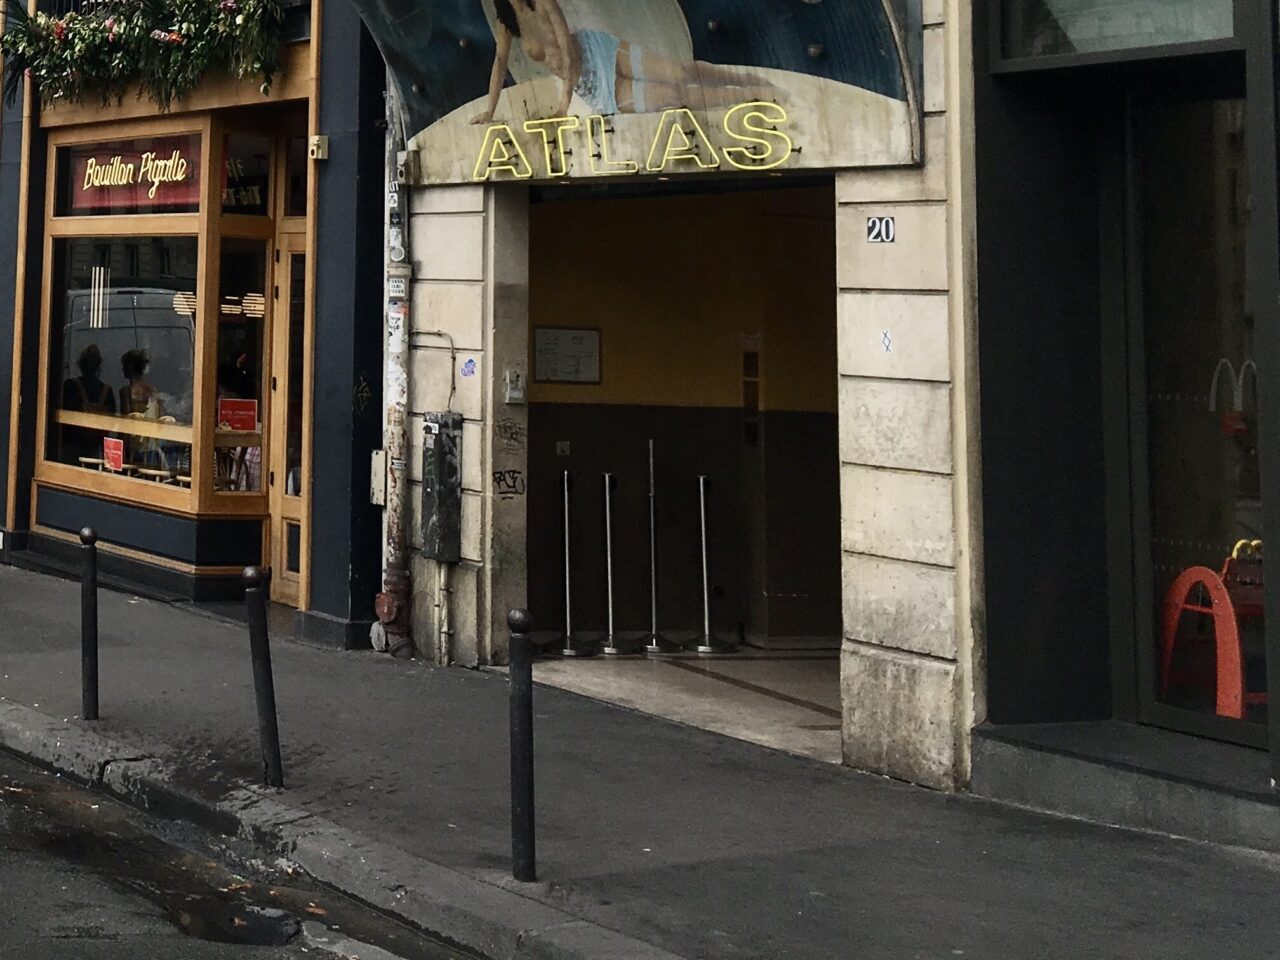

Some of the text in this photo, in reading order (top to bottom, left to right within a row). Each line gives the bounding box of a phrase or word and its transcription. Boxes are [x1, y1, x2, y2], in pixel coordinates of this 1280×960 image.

[473, 101, 792, 181] ATLAS
[83, 155, 134, 191] Bouillon
[138, 150, 187, 199] Pigalle
[867, 217, 895, 242] 20
